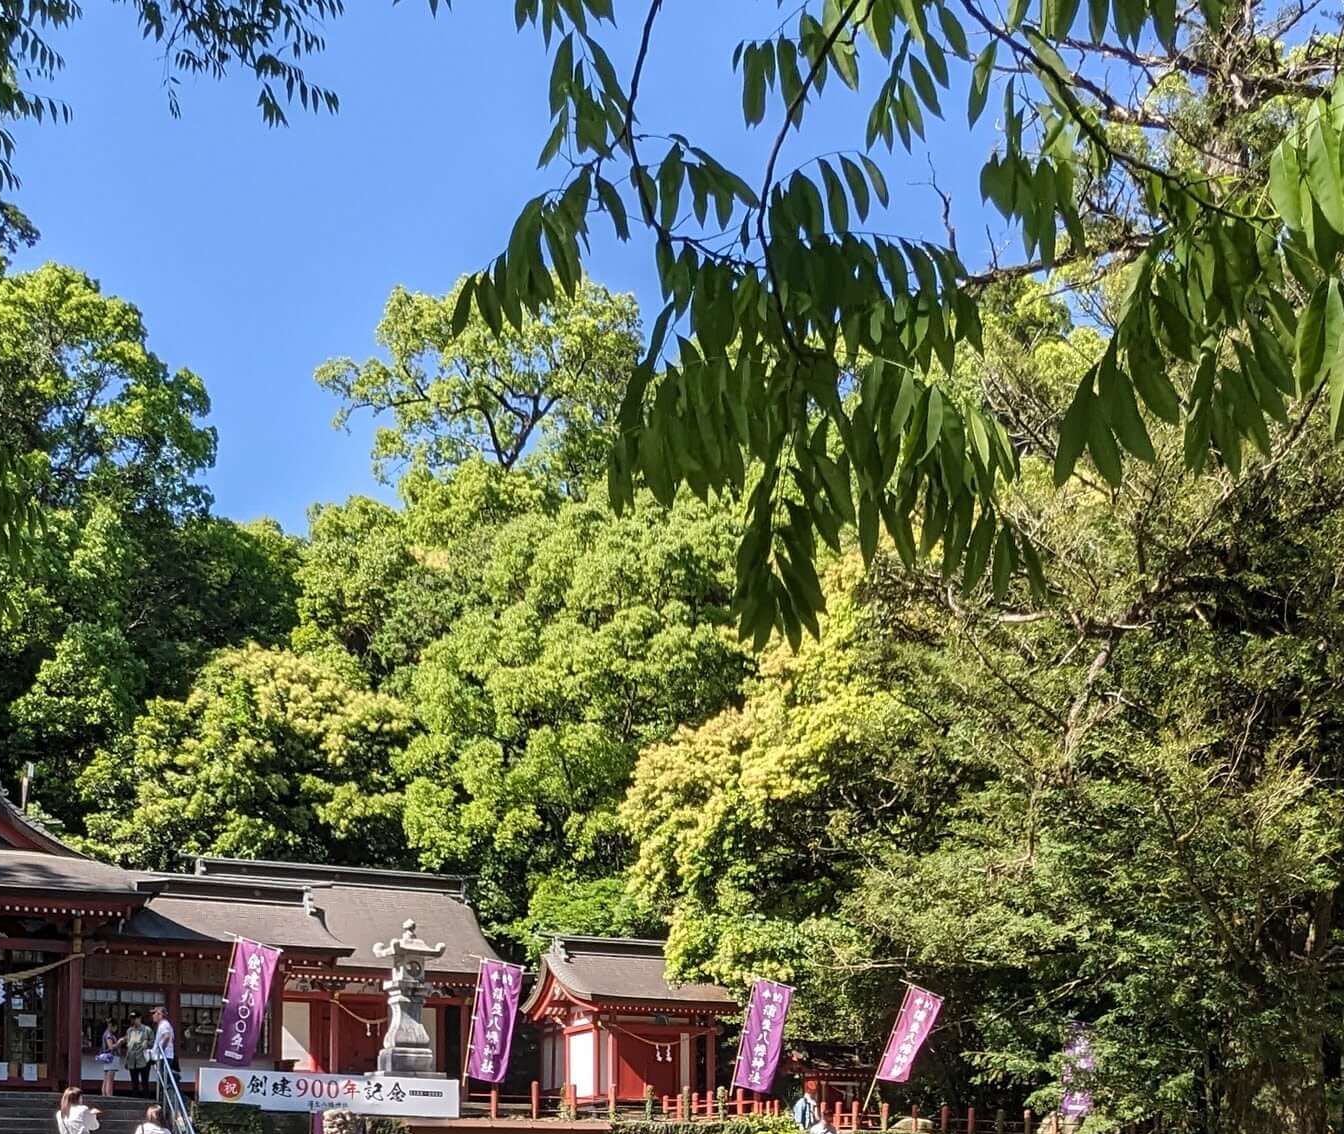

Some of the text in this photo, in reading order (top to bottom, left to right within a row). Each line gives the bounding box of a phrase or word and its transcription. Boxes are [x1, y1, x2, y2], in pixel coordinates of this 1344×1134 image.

[223, 1081, 239, 1095] 祝
[247, 1075, 407, 1103] 創建900年記念
